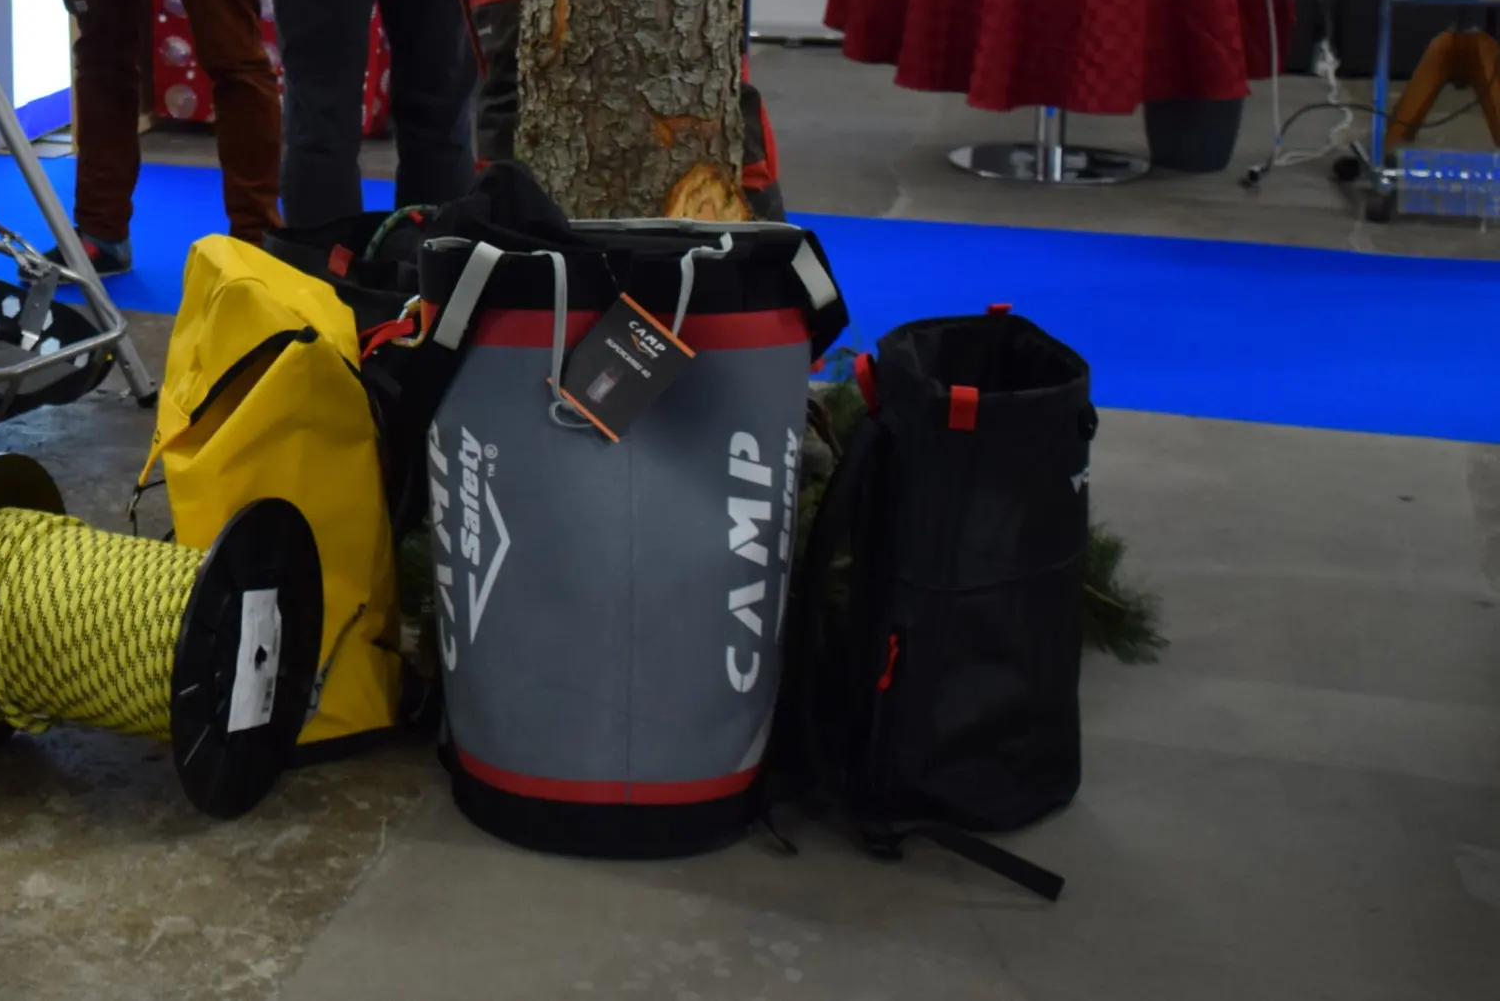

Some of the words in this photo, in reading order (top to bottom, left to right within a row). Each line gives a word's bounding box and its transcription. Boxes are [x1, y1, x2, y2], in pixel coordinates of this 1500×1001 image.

[628, 320, 666, 352] CAMP
[459, 426, 483, 566] Safety
[726, 431, 773, 693] CAMP
